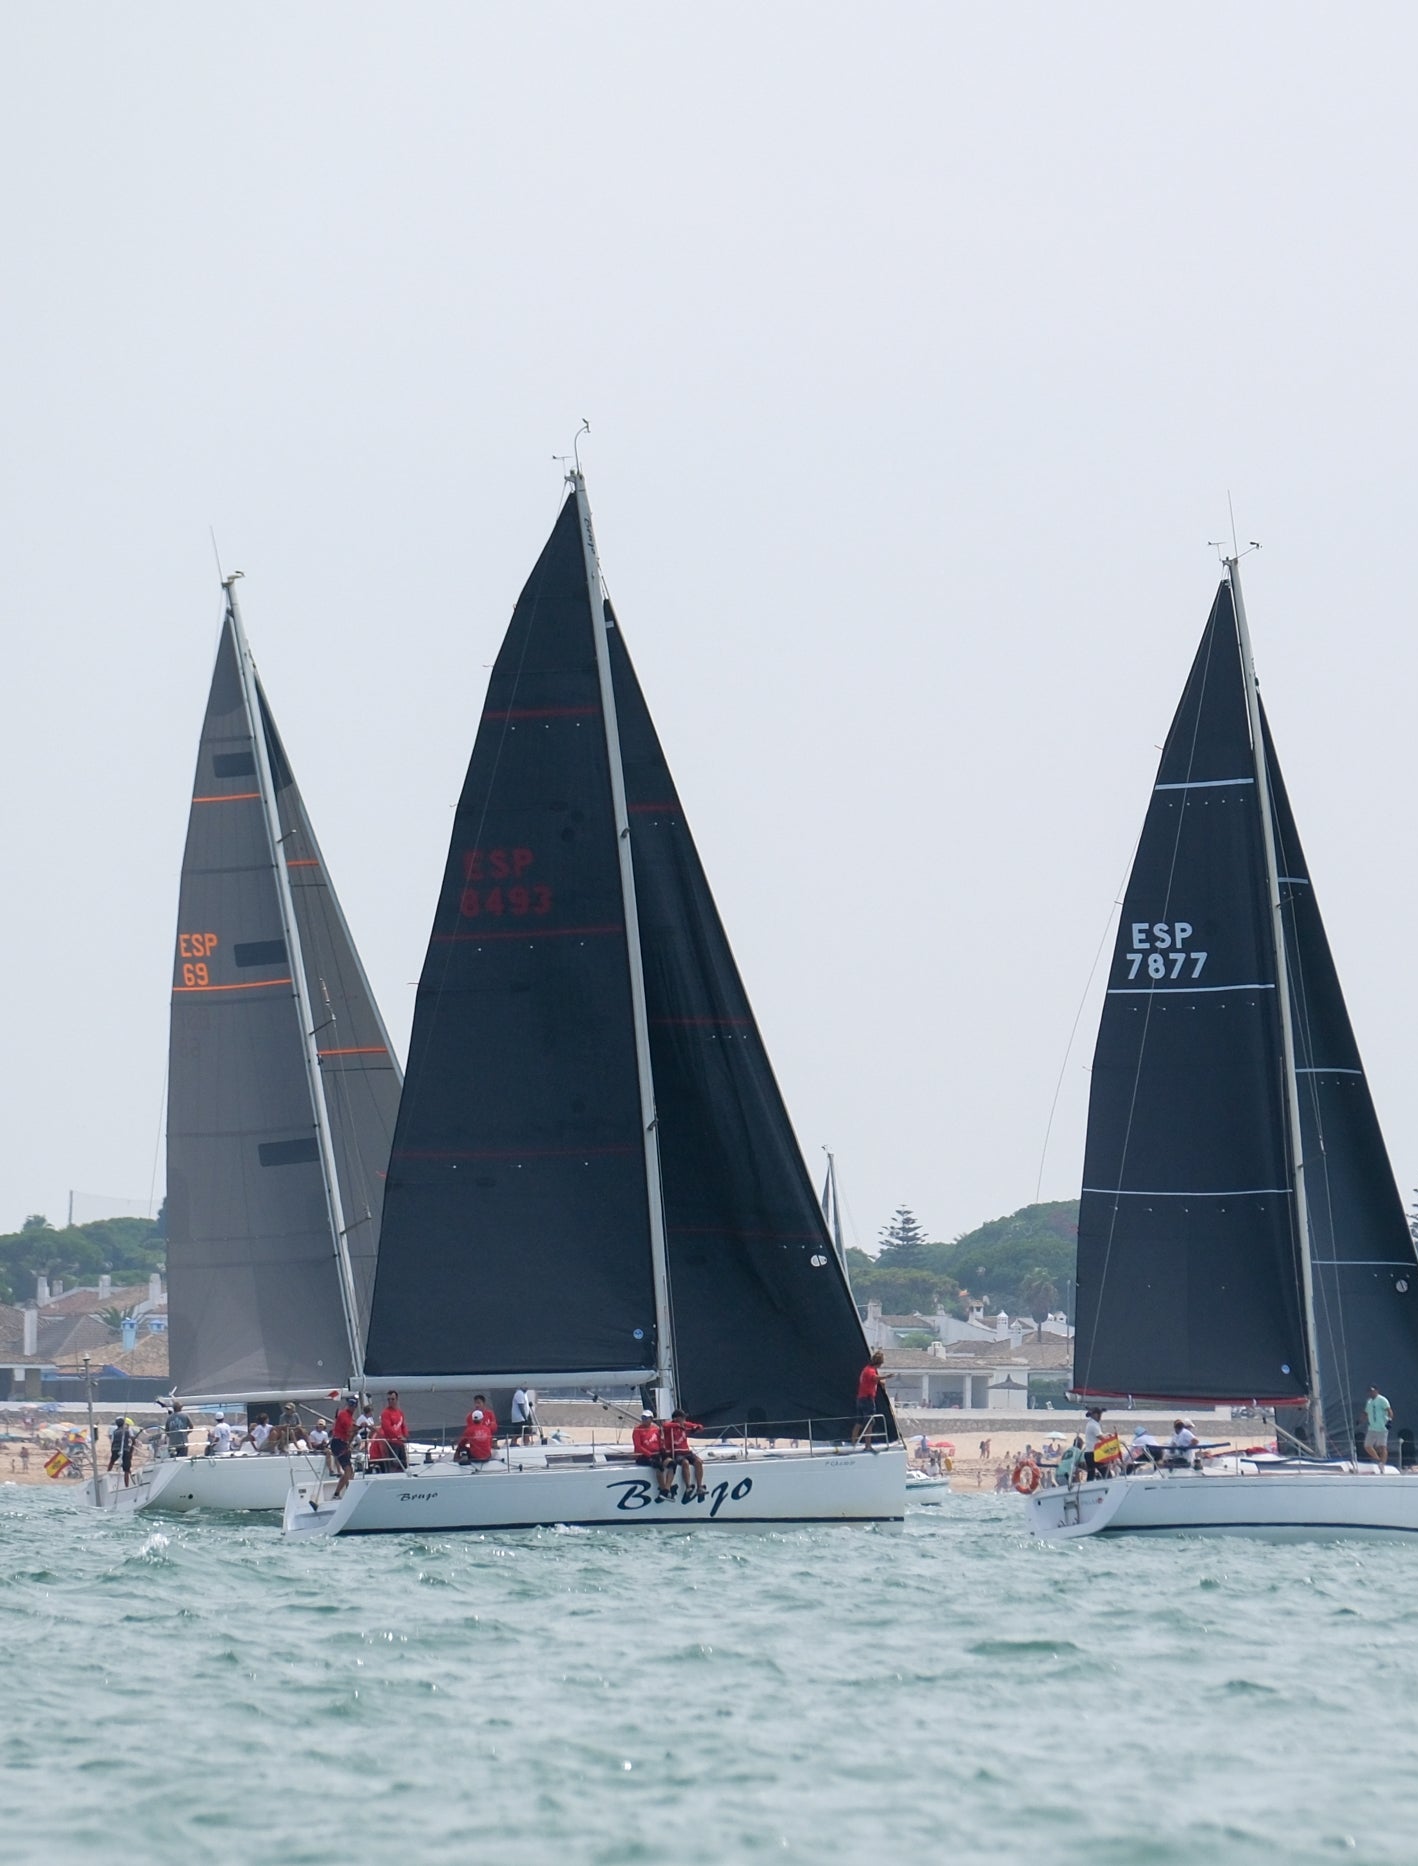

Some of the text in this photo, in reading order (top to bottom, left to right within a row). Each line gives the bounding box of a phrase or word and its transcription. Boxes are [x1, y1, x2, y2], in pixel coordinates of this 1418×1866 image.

[462, 848, 536, 881] ESP
[179, 932, 218, 958] ESP
[1131, 922, 1193, 949] ESP
[182, 962, 209, 987] 69
[1126, 952, 1208, 980] 7877
[606, 1477, 753, 1518] Bujo
